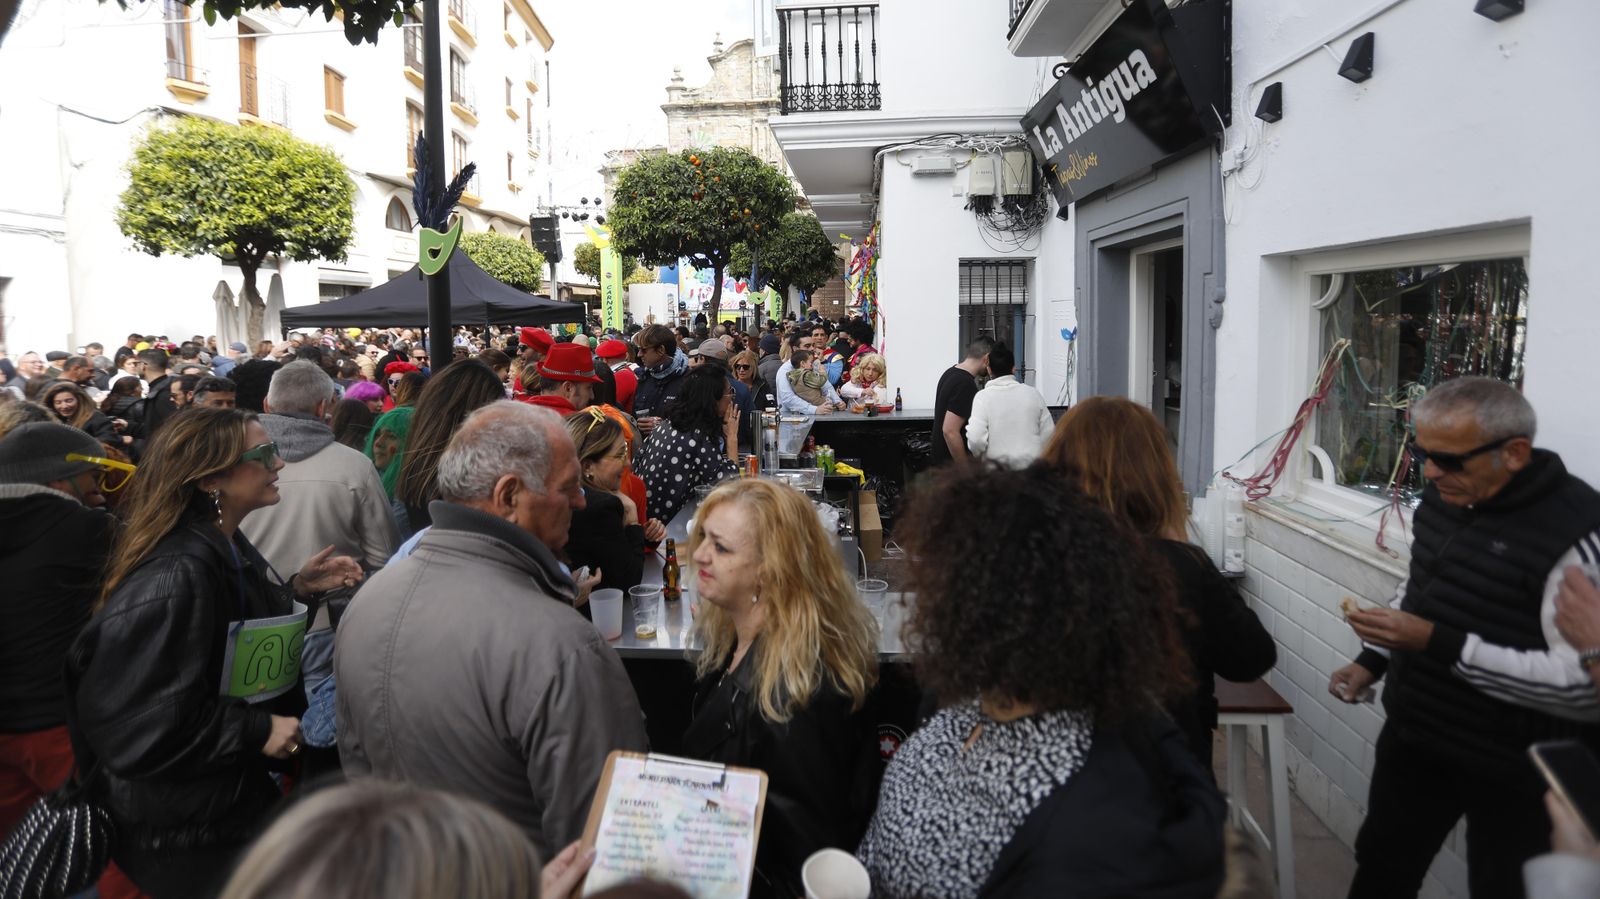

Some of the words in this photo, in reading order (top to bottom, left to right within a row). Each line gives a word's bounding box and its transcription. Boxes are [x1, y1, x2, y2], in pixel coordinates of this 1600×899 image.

[1033, 125, 1064, 160] La
[1056, 49, 1157, 144] Antigua
[606, 284, 614, 327] CARNAVAL
